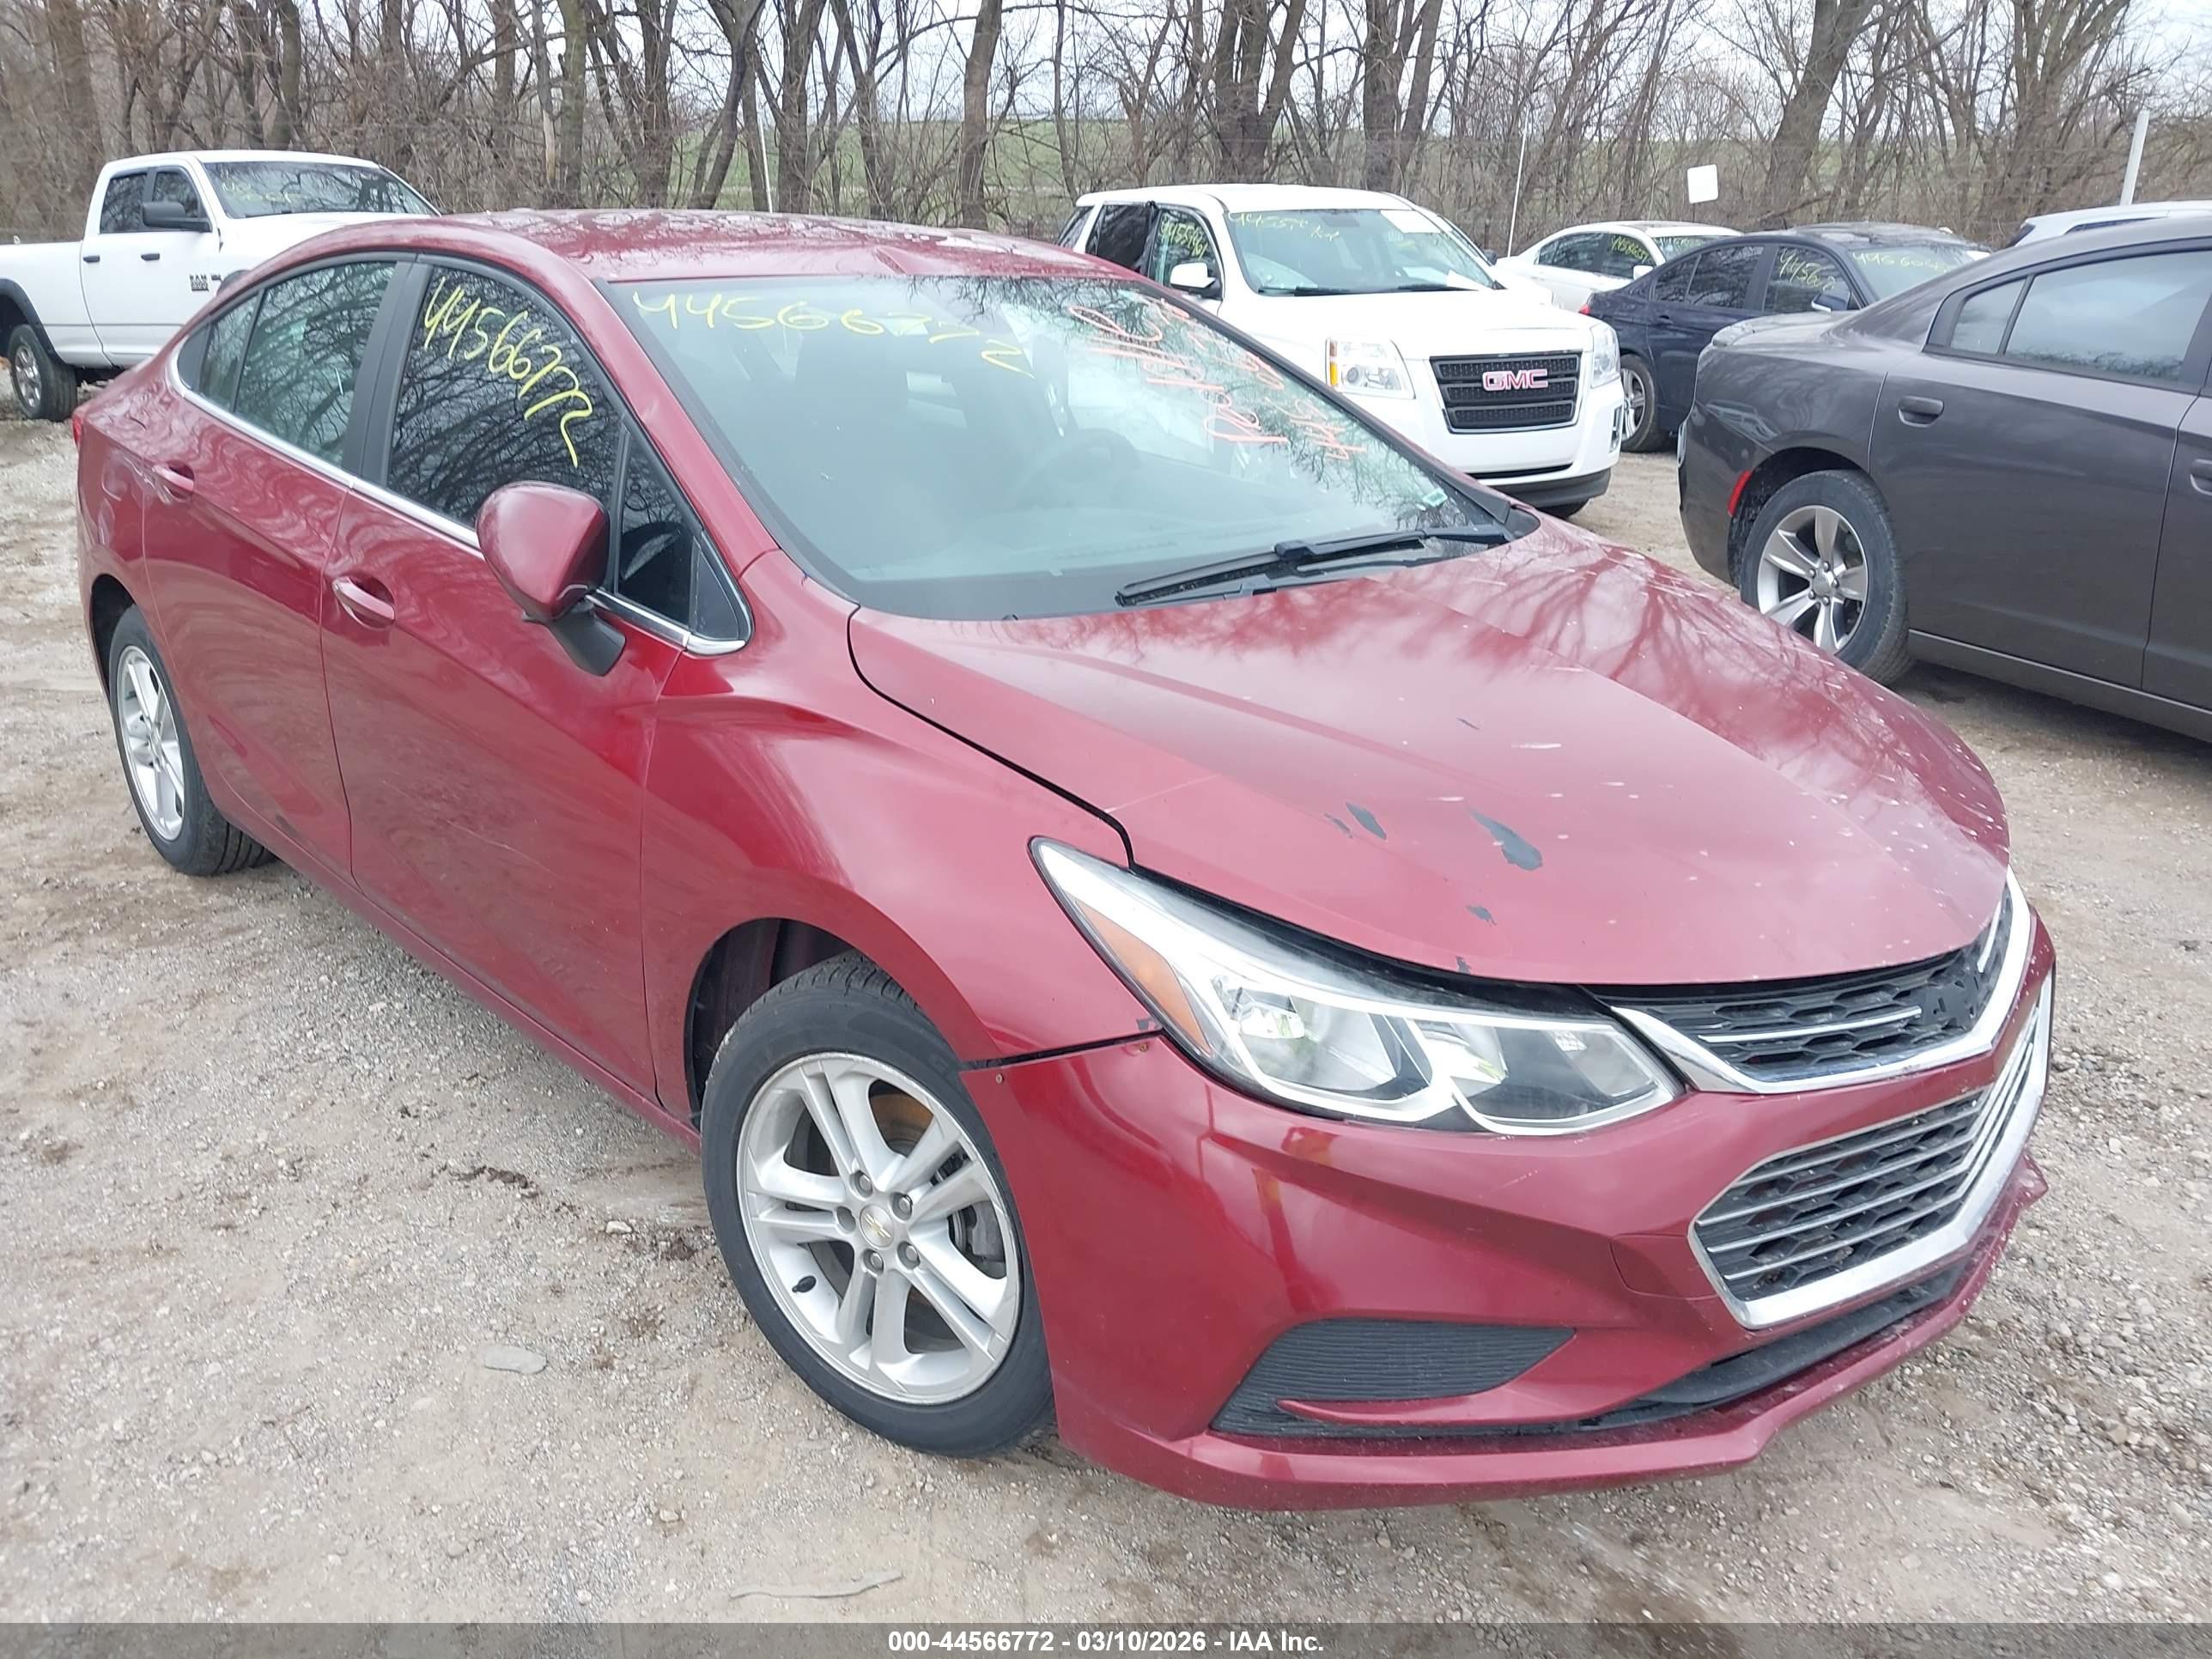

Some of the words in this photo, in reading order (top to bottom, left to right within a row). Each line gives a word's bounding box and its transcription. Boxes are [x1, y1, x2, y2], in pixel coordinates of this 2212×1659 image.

[424, 276, 593, 469] 44566772
[633, 290, 1036, 378] 44566772
[1482, 368, 1548, 392] GMC
